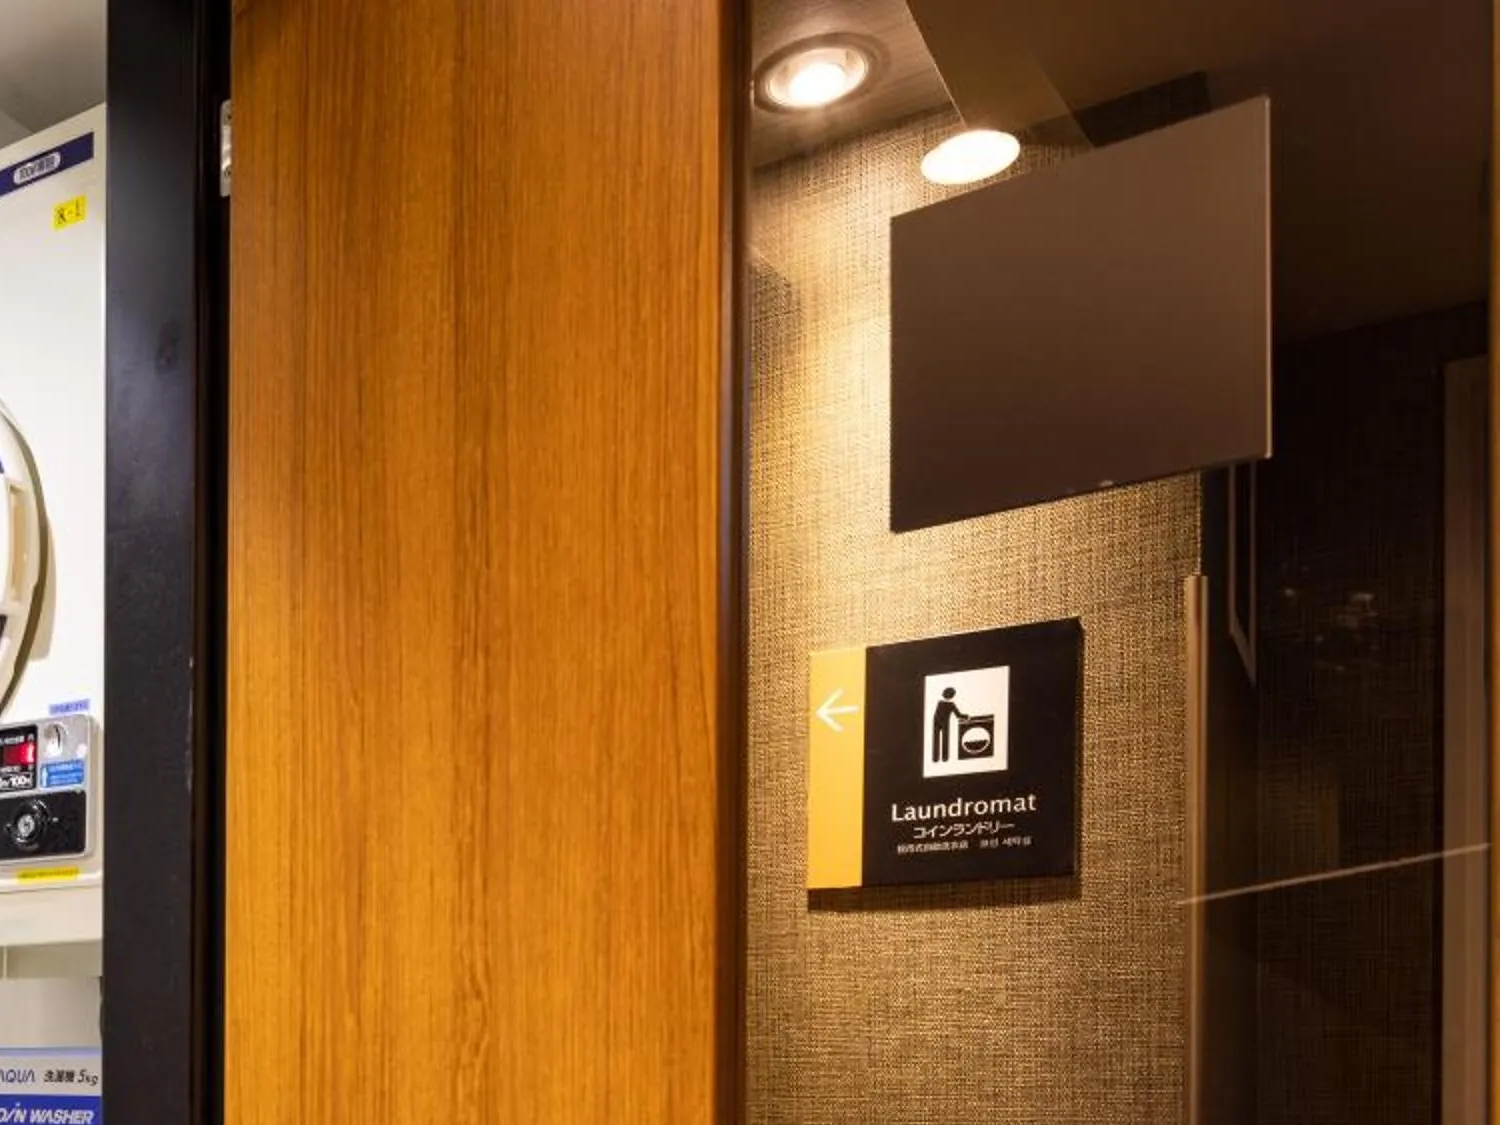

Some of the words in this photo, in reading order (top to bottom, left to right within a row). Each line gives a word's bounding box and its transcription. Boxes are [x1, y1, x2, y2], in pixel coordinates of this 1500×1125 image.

[891, 794, 1037, 822] Laundromat
[913, 820, 1016, 839] コインランドリー
[77, 1068, 100, 1087] 5kg
[29, 1108, 95, 1125] WASHER
